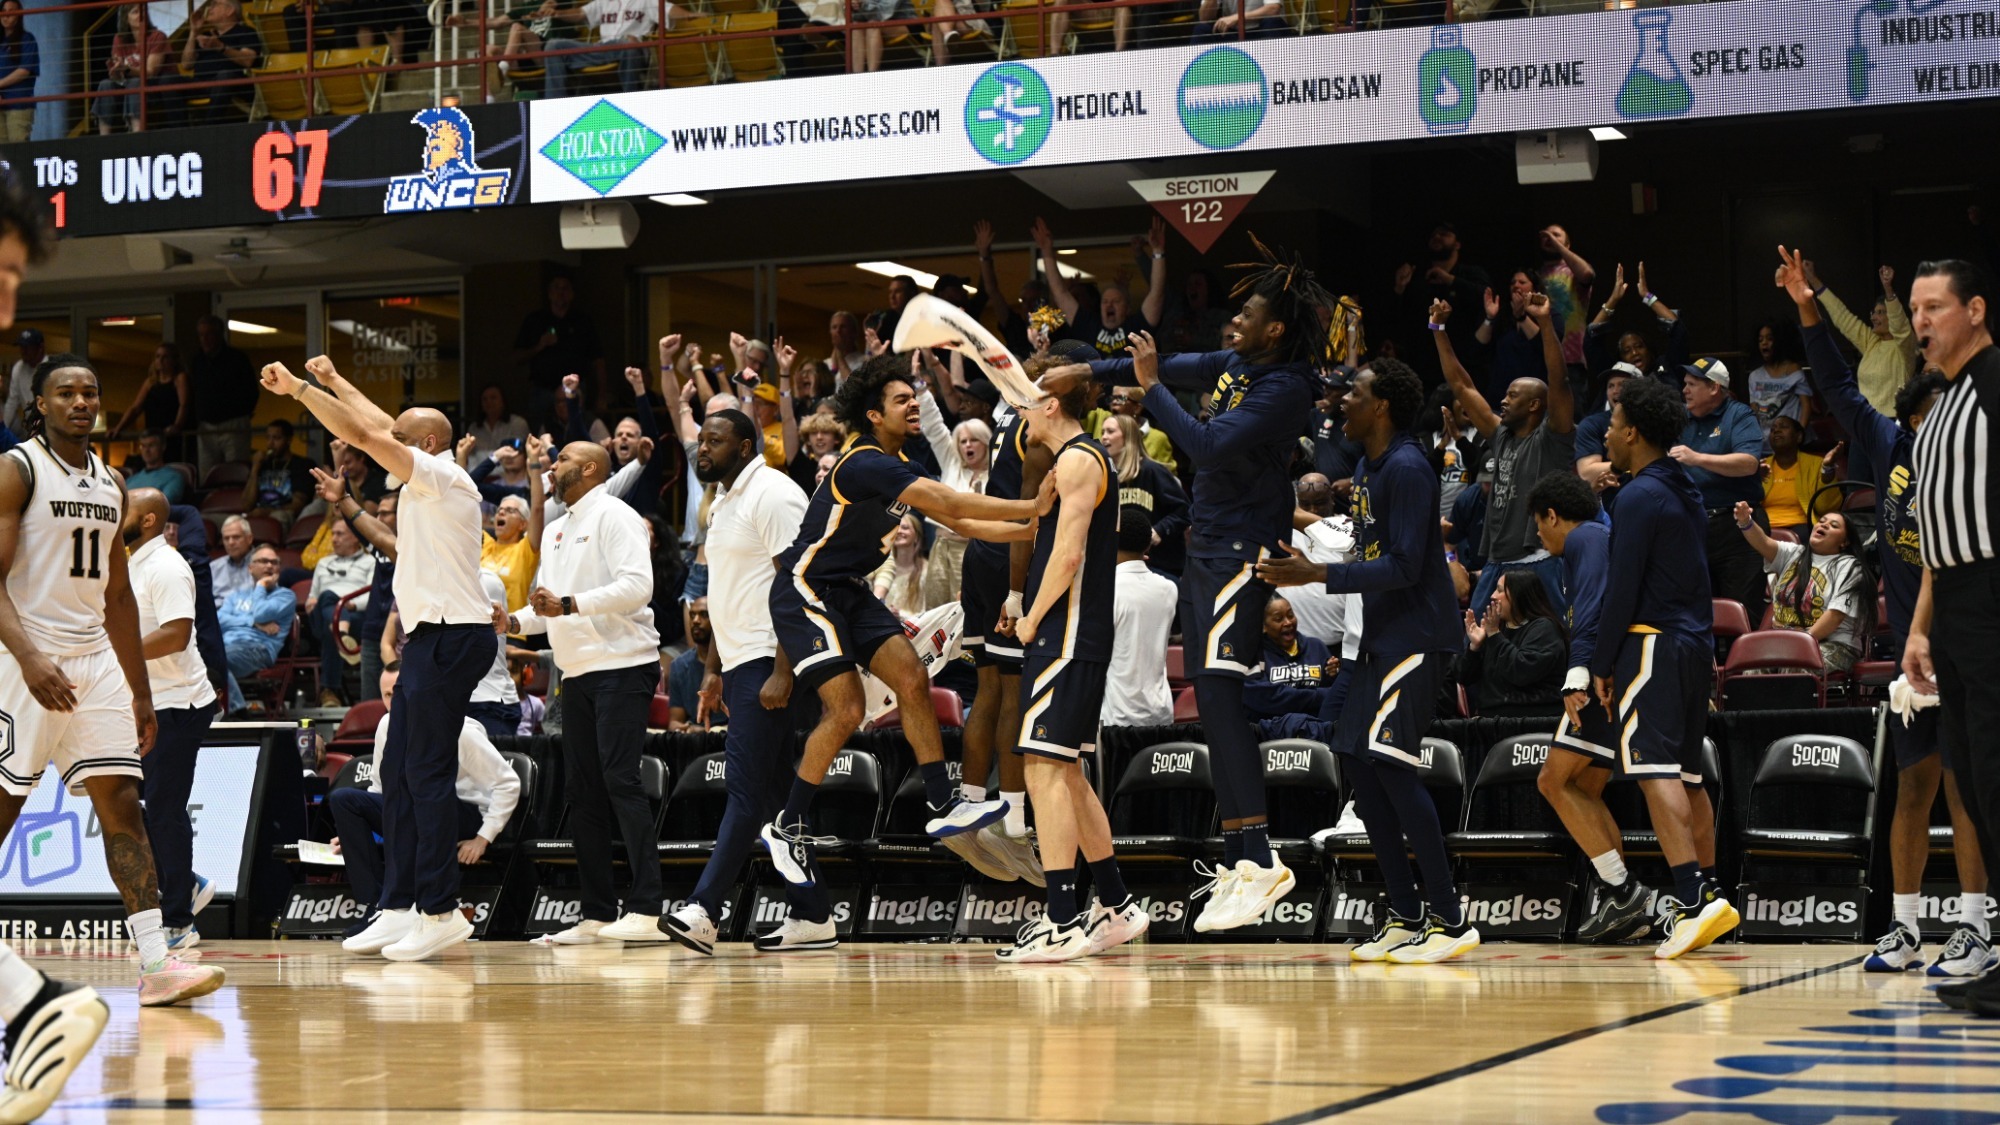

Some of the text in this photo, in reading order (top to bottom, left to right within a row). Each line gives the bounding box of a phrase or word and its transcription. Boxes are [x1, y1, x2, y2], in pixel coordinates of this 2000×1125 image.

[1880, 11, 2000, 47] INDUSTRI
[1690, 42, 1804, 76] SPEC GAS
[1272, 74, 1382, 105] BANDSAW
[1479, 60, 1585, 93] PROPANE
[1057, 90, 1148, 121] MEDICAL
[558, 127, 647, 161] HOLSTON
[671, 108, 940, 153] WWW.HOLSTONGASES.COM
[101, 152, 203, 205] UNCG
[252, 130, 329, 211] 67
[1165, 177, 1240, 196] SECTION
[386, 174, 506, 212] UNCG
[50, 192, 66, 228] 1
[1181, 201, 1224, 223] 122
[353, 348, 438, 367] CHEROKEE
[353, 364, 438, 383] CASINOS
[49, 501, 117, 523] WOFFORD
[69, 526, 101, 579] 11
[286, 894, 370, 923] ingles
[1460, 893, 1562, 926] ingles
[1746, 893, 1858, 926] ingles
[0, 919, 37, 938] TER
